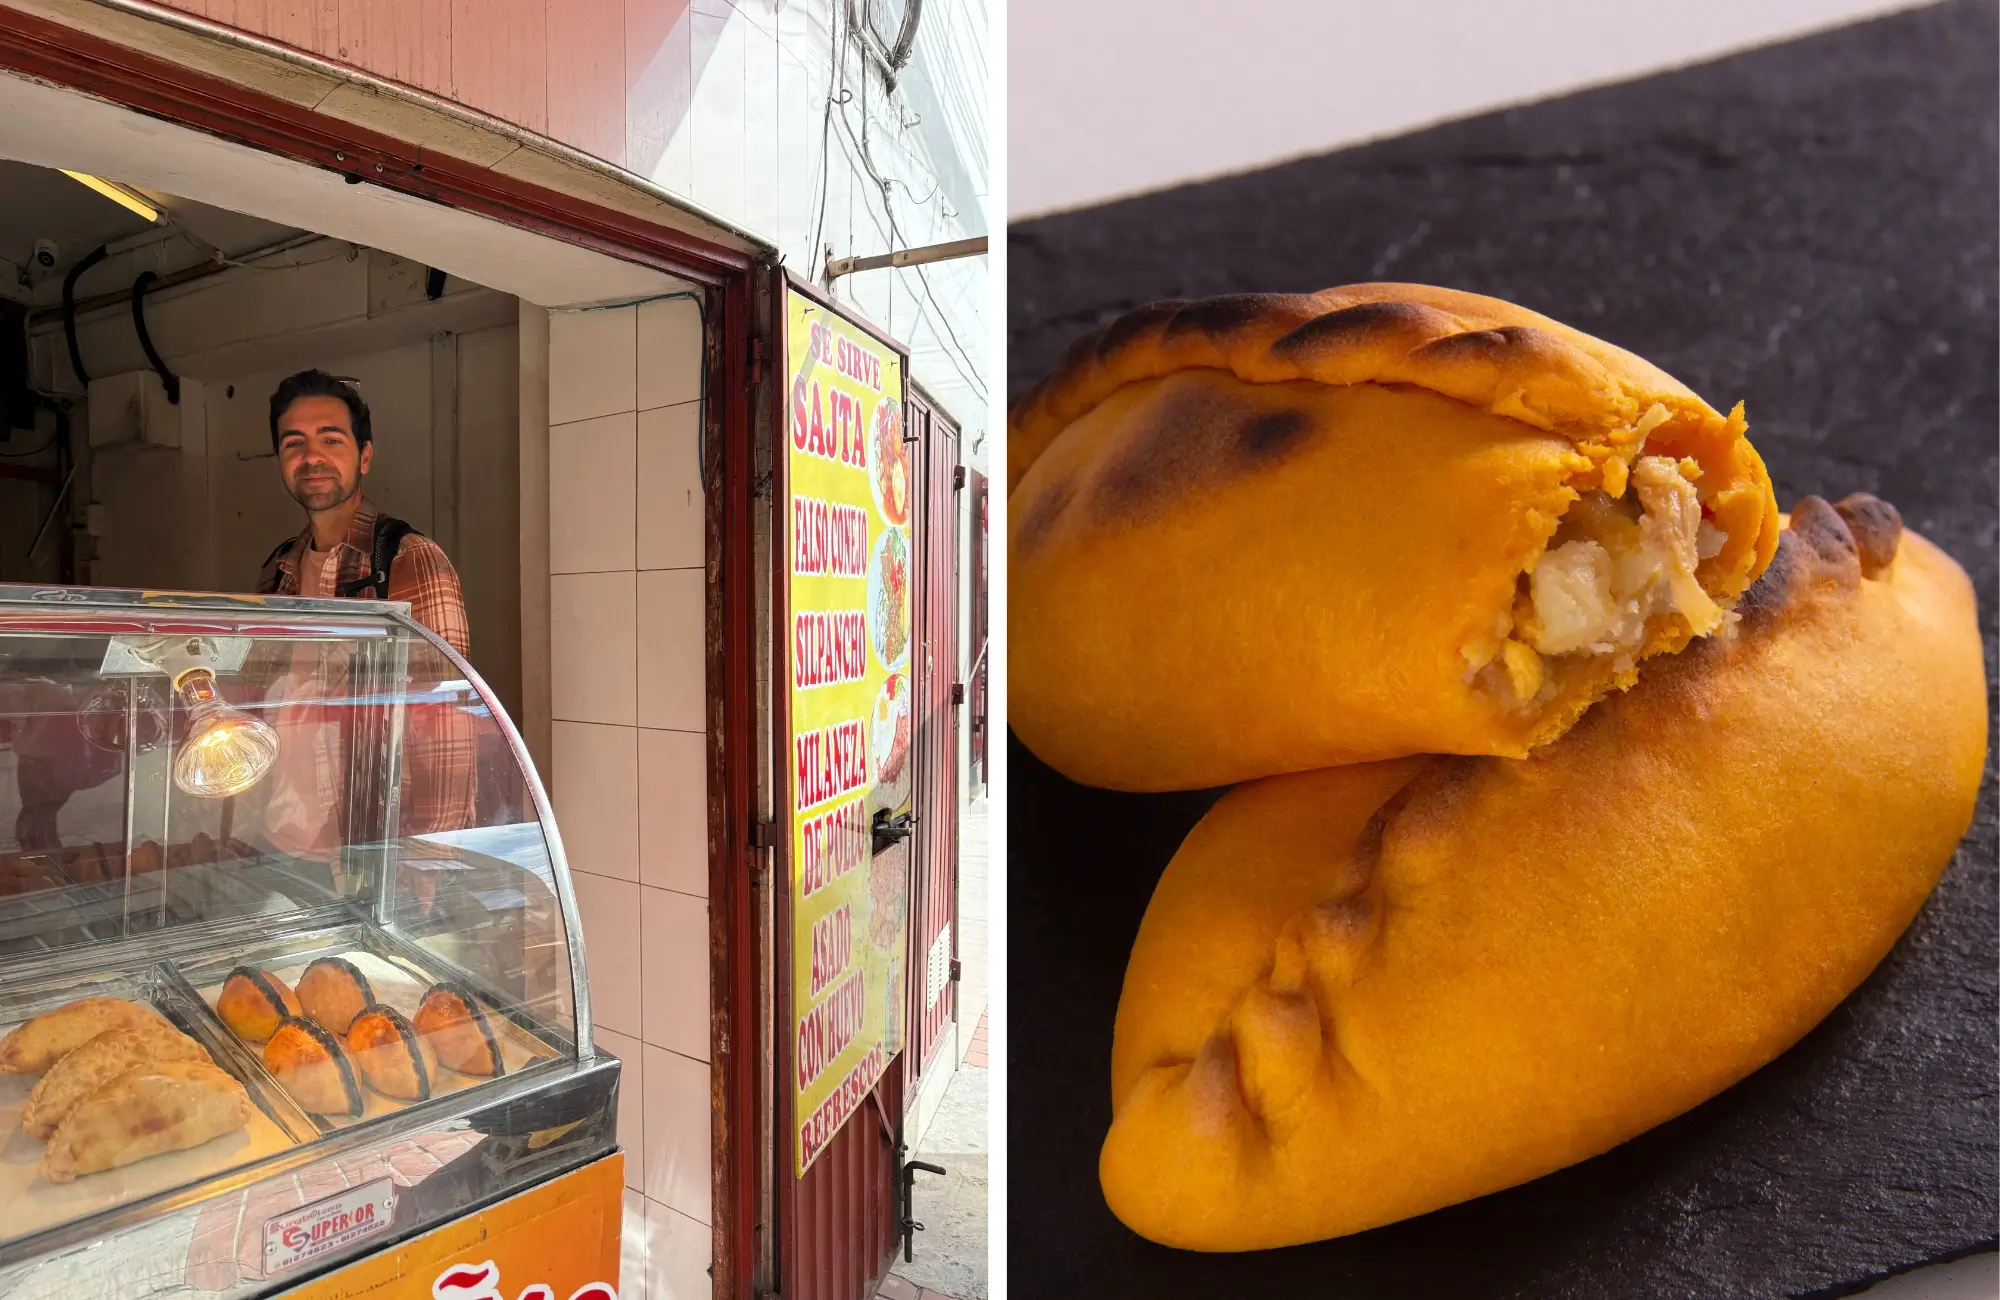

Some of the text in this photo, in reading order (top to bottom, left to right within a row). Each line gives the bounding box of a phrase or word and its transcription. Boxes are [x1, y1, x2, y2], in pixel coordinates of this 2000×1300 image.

[810, 322, 882, 392] SE SIRVE
[793, 374, 866, 468] SAJTA
[794, 498, 867, 576] FALSO CONEJO
[795, 612, 866, 688] SILPANCHO
[796, 723, 867, 811] MILANEZA
[803, 797, 865, 897] DE POLLO
[810, 903, 850, 997] ASADO
[798, 968, 864, 1091] CON HUEVO
[800, 1040, 883, 1168] REFRESCOS
